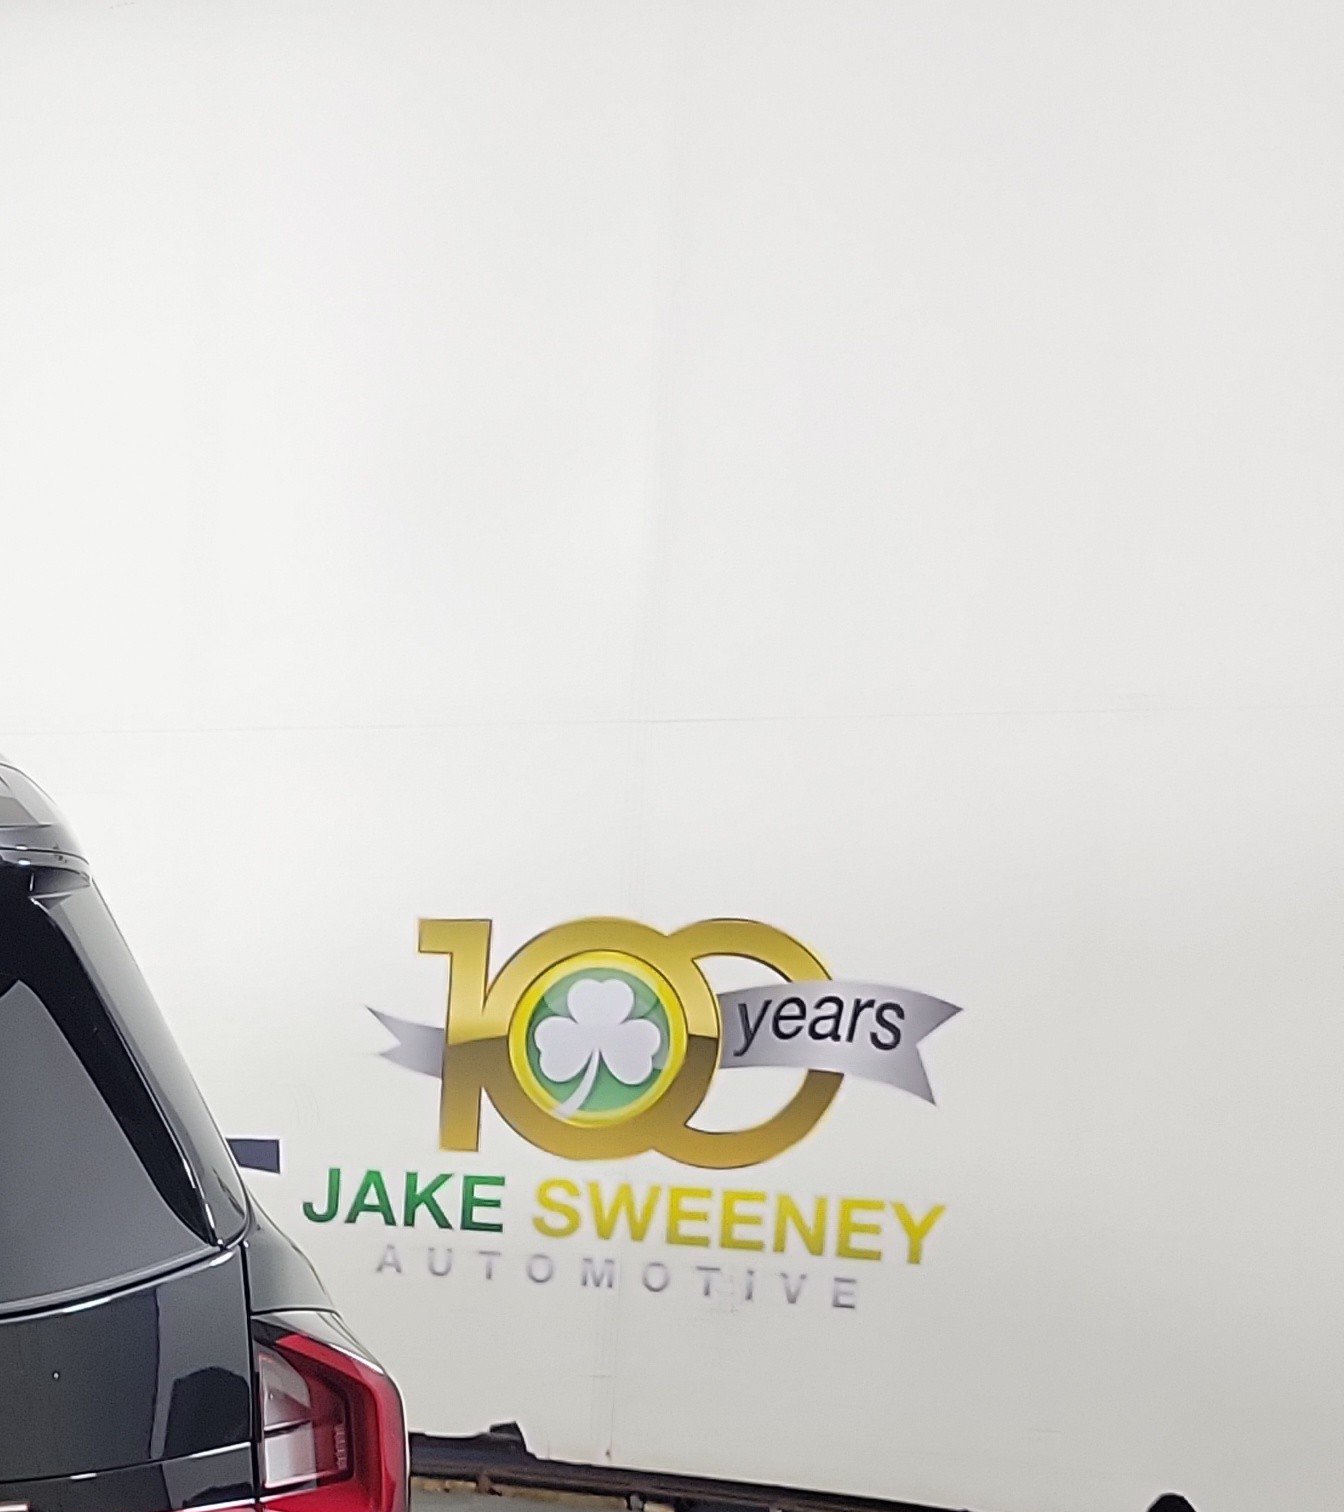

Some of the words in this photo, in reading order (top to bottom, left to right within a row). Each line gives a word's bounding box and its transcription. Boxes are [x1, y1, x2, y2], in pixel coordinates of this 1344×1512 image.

[733, 994, 906, 1057] years
[302, 1166, 506, 1233] JAKE
[531, 1178, 946, 1265] SWEENEY
[376, 1244, 858, 1309] AUTOMOTIVE
